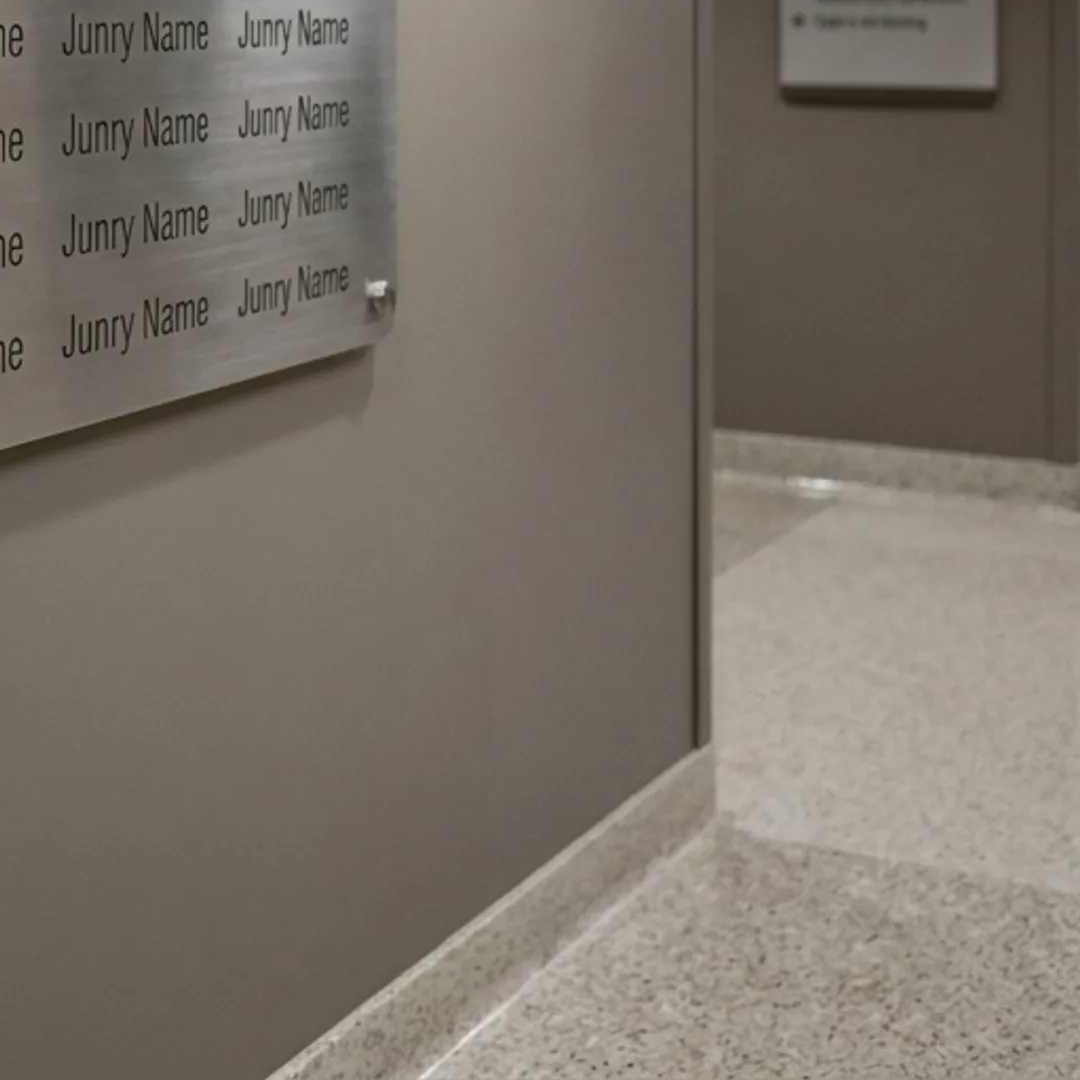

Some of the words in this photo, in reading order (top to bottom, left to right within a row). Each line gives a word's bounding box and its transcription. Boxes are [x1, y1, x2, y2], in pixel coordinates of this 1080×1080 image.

[61, 12, 135, 64] Junry
[143, 11, 210, 53] Name
[237, 9, 293, 57] Junry
[297, 8, 350, 47] Name
[61, 113, 135, 161] Junry
[143, 106, 210, 148] Name
[237, 99, 293, 144] Junry
[297, 94, 350, 132] Name
[61, 213, 136, 259] Junry
[143, 201, 210, 244] Name
[237, 189, 293, 230] Junry
[297, 180, 350, 218] Name
[237, 277, 293, 318] Junry
[297, 265, 350, 302] Name
[61, 312, 136, 359] Junry
[143, 296, 210, 340] Name
